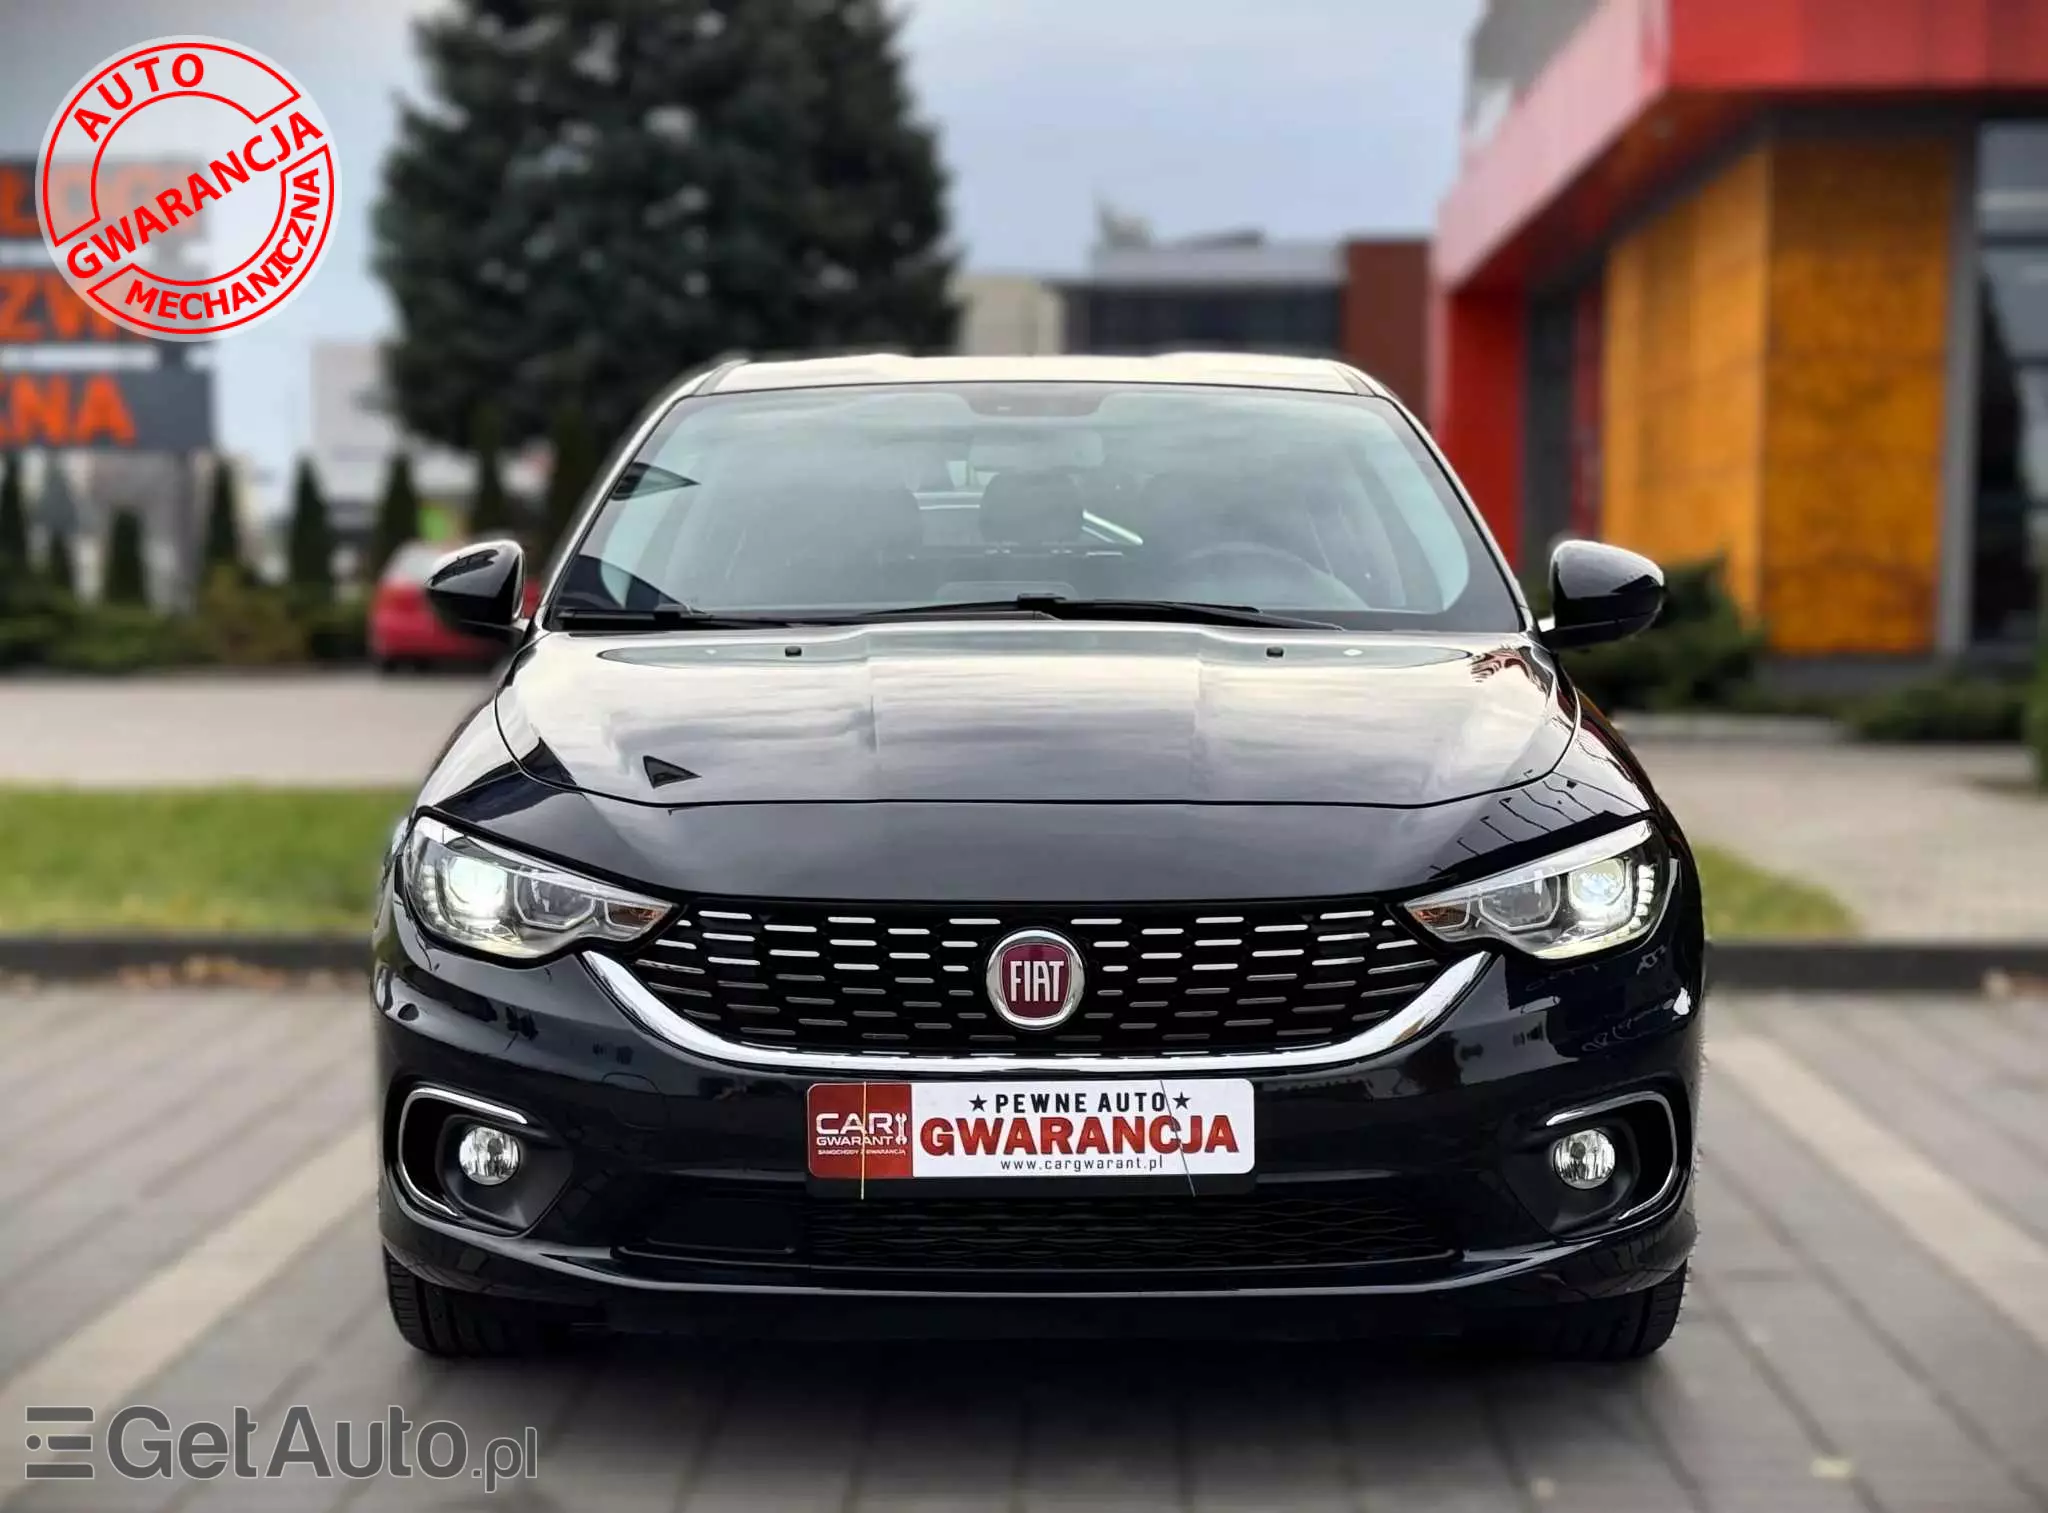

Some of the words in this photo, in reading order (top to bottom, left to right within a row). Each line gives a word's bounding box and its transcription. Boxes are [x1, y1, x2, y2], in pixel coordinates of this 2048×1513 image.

[1009, 960, 1065, 1002] FIAT
[995, 1093, 1088, 1114] PEWNE
[1097, 1091, 1166, 1113] AUTO
[815, 1112, 894, 1135] CAR
[816, 1135, 894, 1147] GWARANT
[919, 1114, 1240, 1157] GWARANCJA
[1000, 1154, 1163, 1173] www.cargwarant.pl
